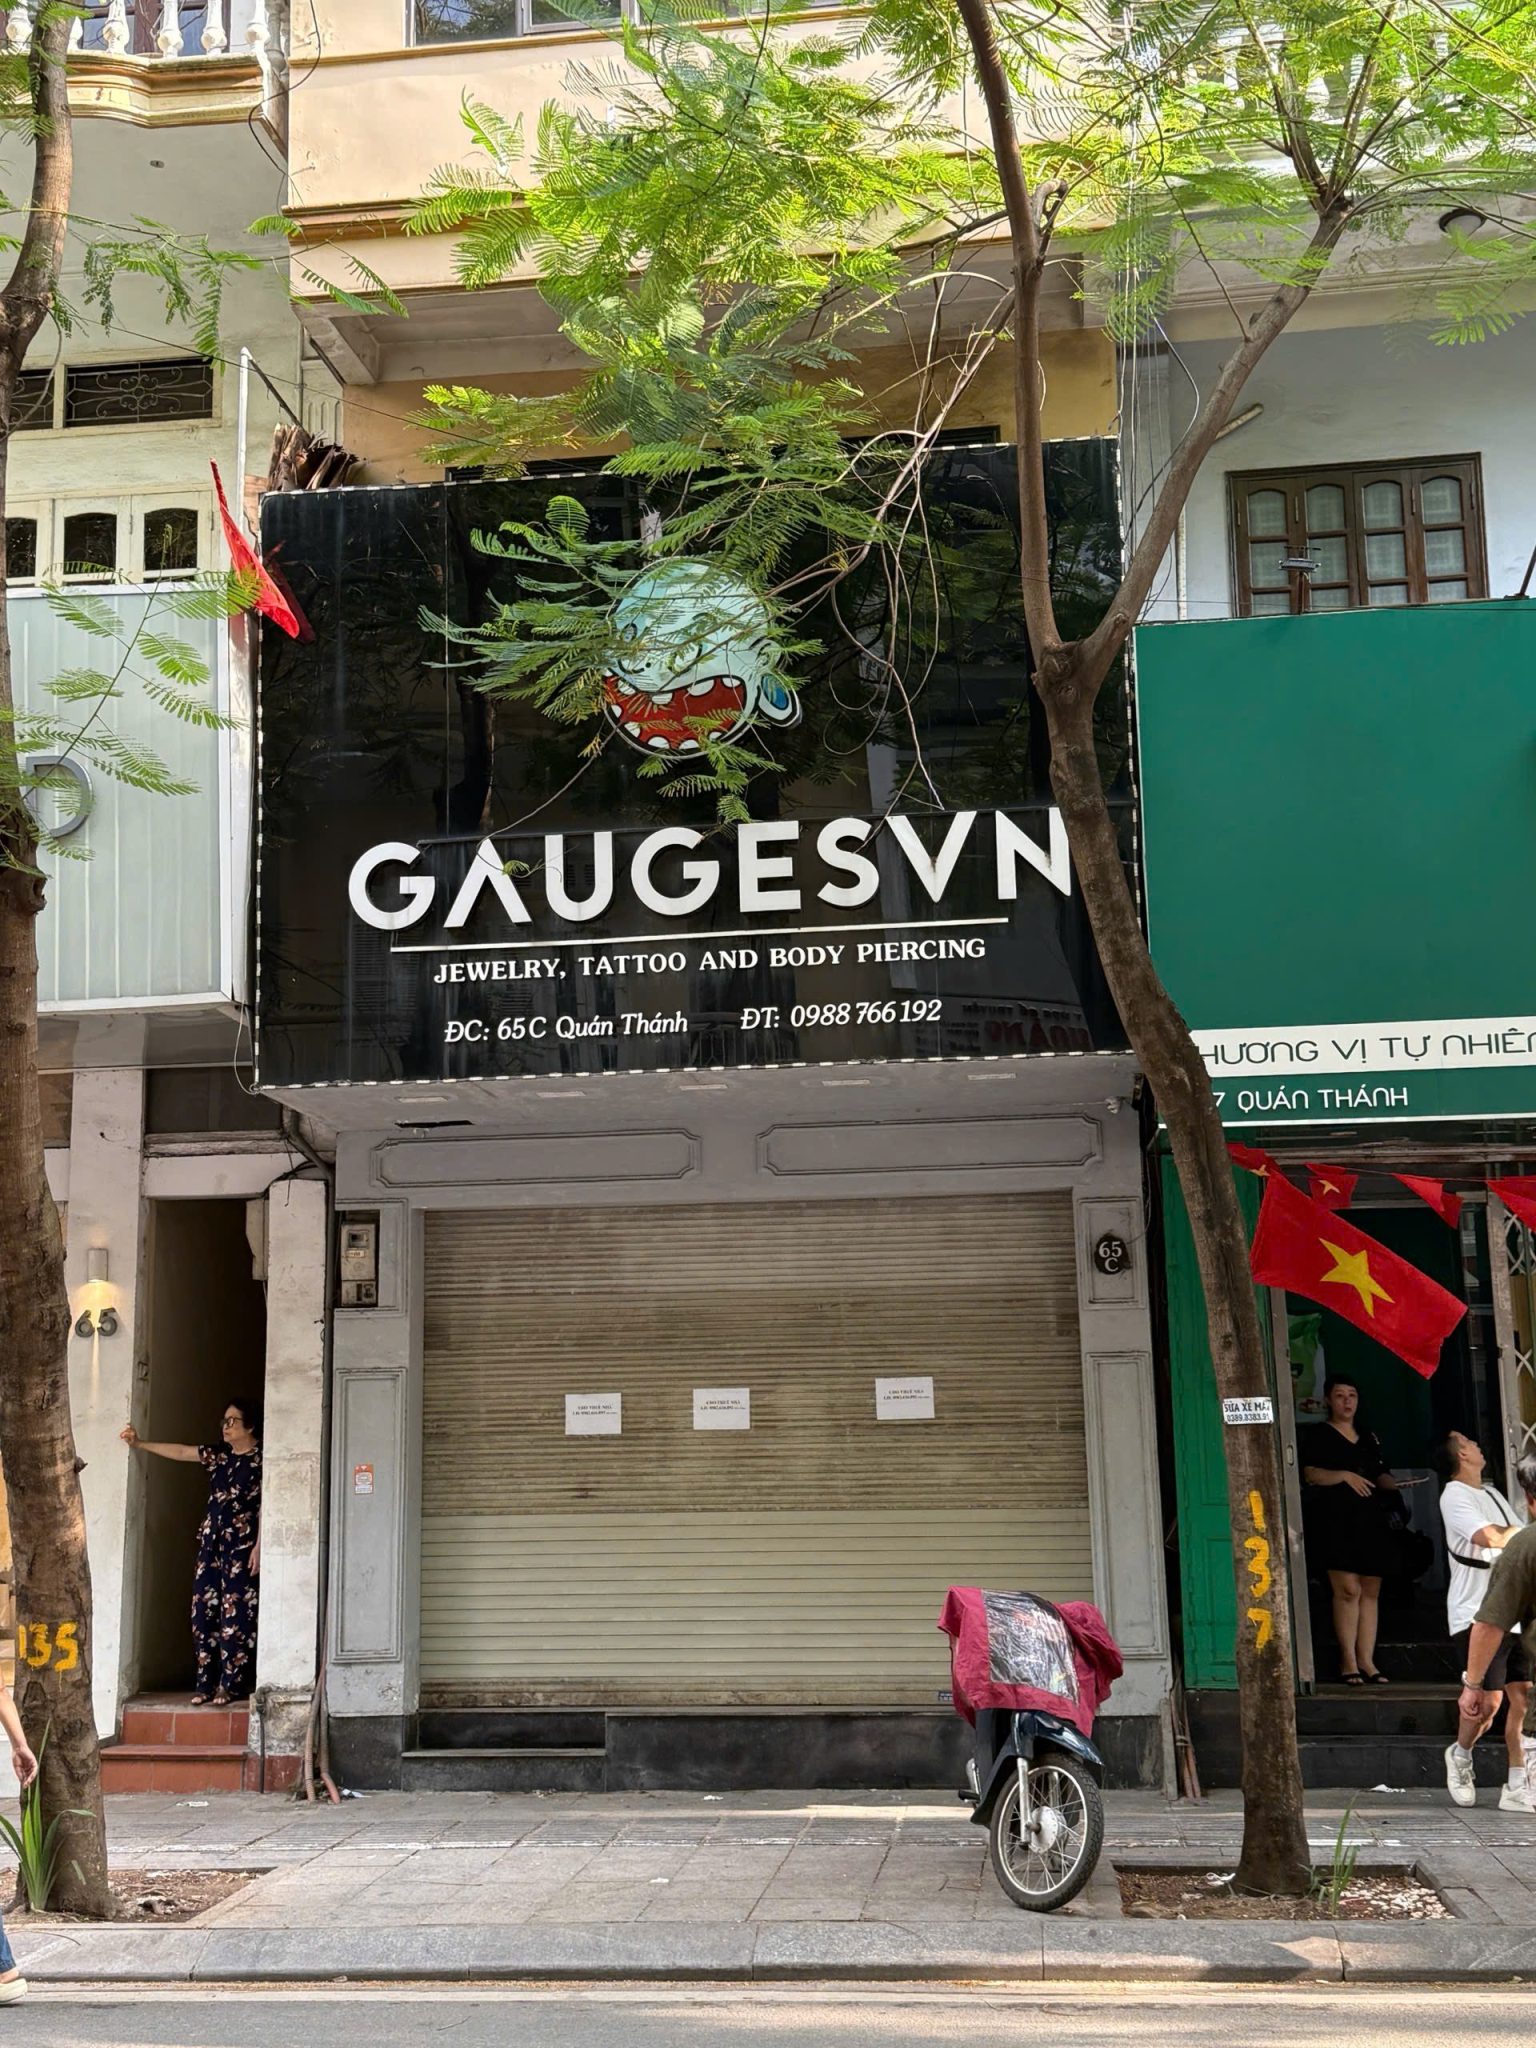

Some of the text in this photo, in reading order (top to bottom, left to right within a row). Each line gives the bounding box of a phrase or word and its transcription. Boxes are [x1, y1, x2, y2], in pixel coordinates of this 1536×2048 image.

[349, 807, 1071, 930] GAUGESVN
[434, 938, 986, 984] JEWELRY, TATTOO AND BODY PIERCING
[444, 1020, 490, 1043] ĐC:
[555, 1015, 614, 1040] Quán
[620, 1011, 688, 1036] Thánh
[740, 1007, 780, 1030] ĐT:
[1332, 1038, 1367, 1063] VỊ
[1379, 1035, 1431, 1062] TỰ
[1238, 1085, 1309, 1113] QUÁN
[1317, 1083, 1409, 1109] THÁNH
[1098, 1241, 1122, 1258] 65
[1104, 1257, 1119, 1272] C
[74, 1307, 118, 1337] 65
[18, 1622, 79, 1673] 135
